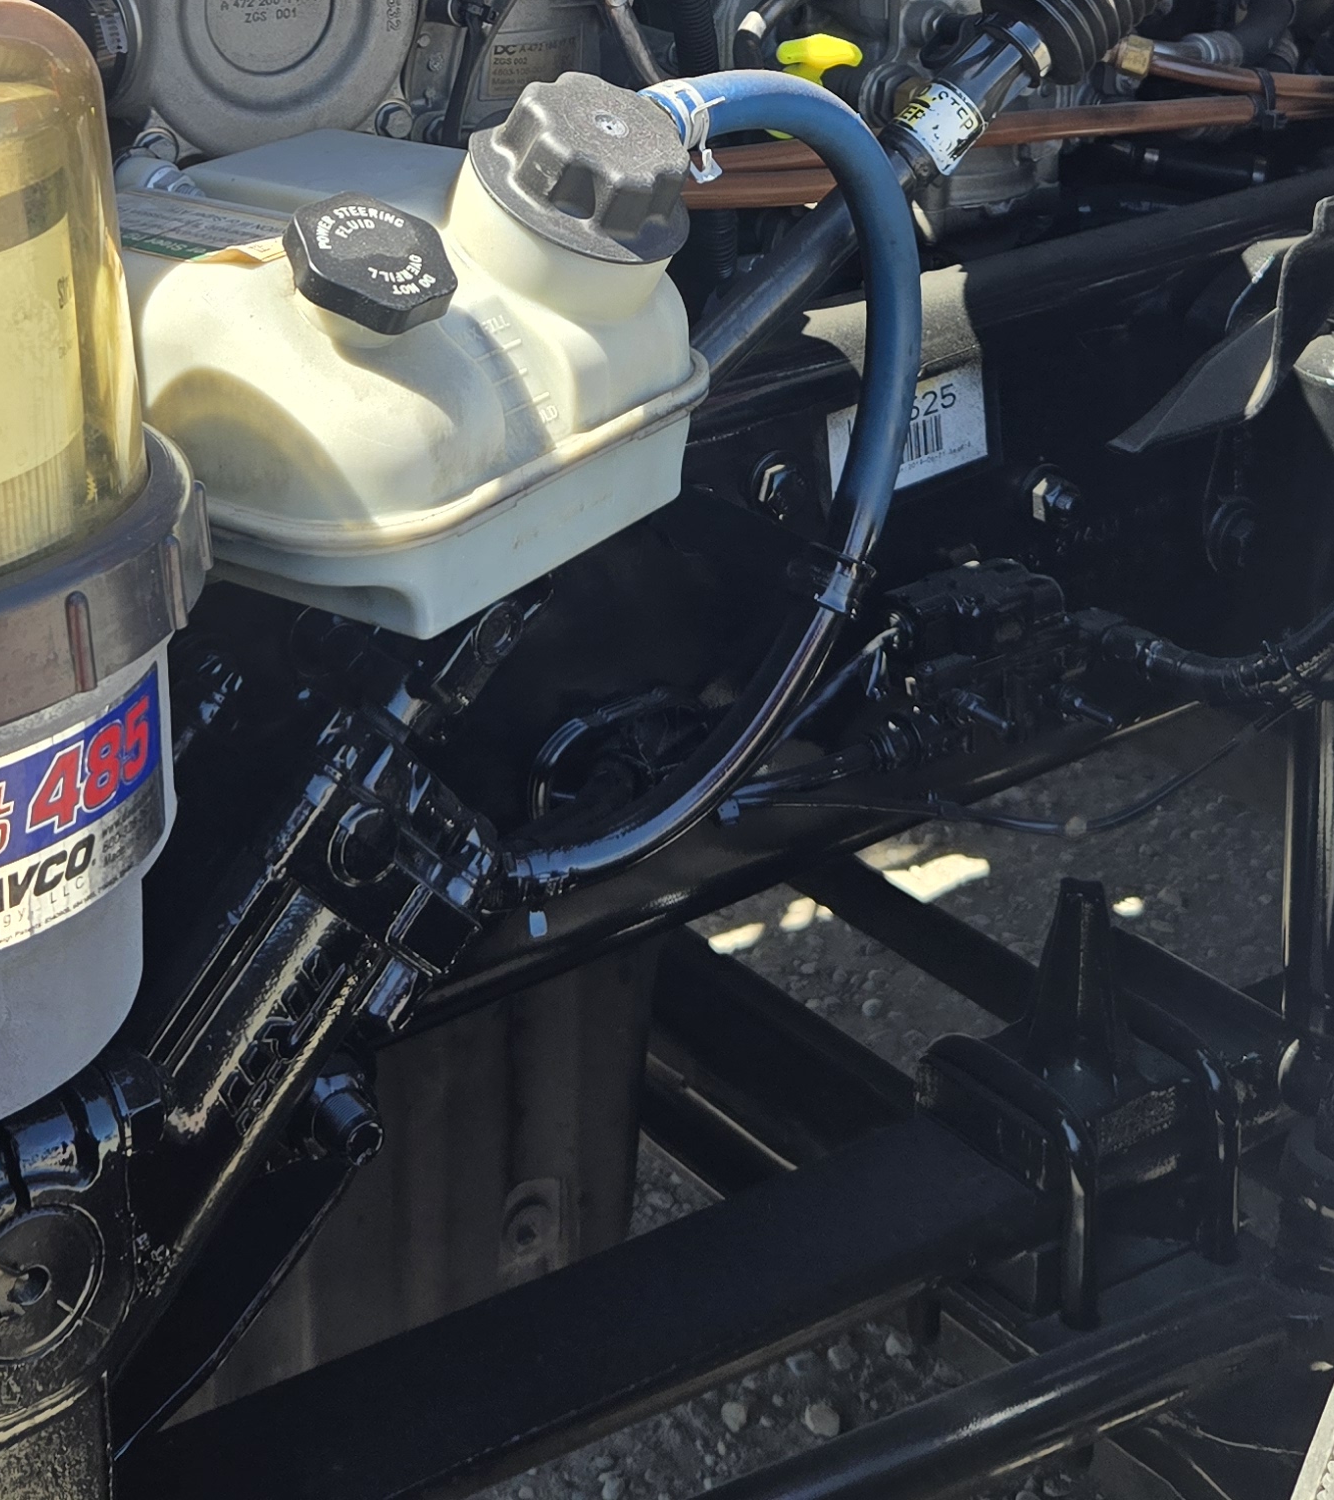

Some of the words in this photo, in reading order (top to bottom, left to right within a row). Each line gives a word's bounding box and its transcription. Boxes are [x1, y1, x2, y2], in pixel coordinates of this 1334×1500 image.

[221, 2, 229, 11] A
[276, 8, 297, 20] 001
[493, 44, 516, 55] DC
[315, 215, 336, 250] POWER
[333, 205, 404, 228] STEERING
[335, 218, 376, 239] FLUID
[367, 254, 422, 283] OVERFILL
[392, 283, 420, 295] NOT
[419, 273, 436, 289] DO
[26, 695, 150, 834] 485
[50, 876, 85, 904] LLC
